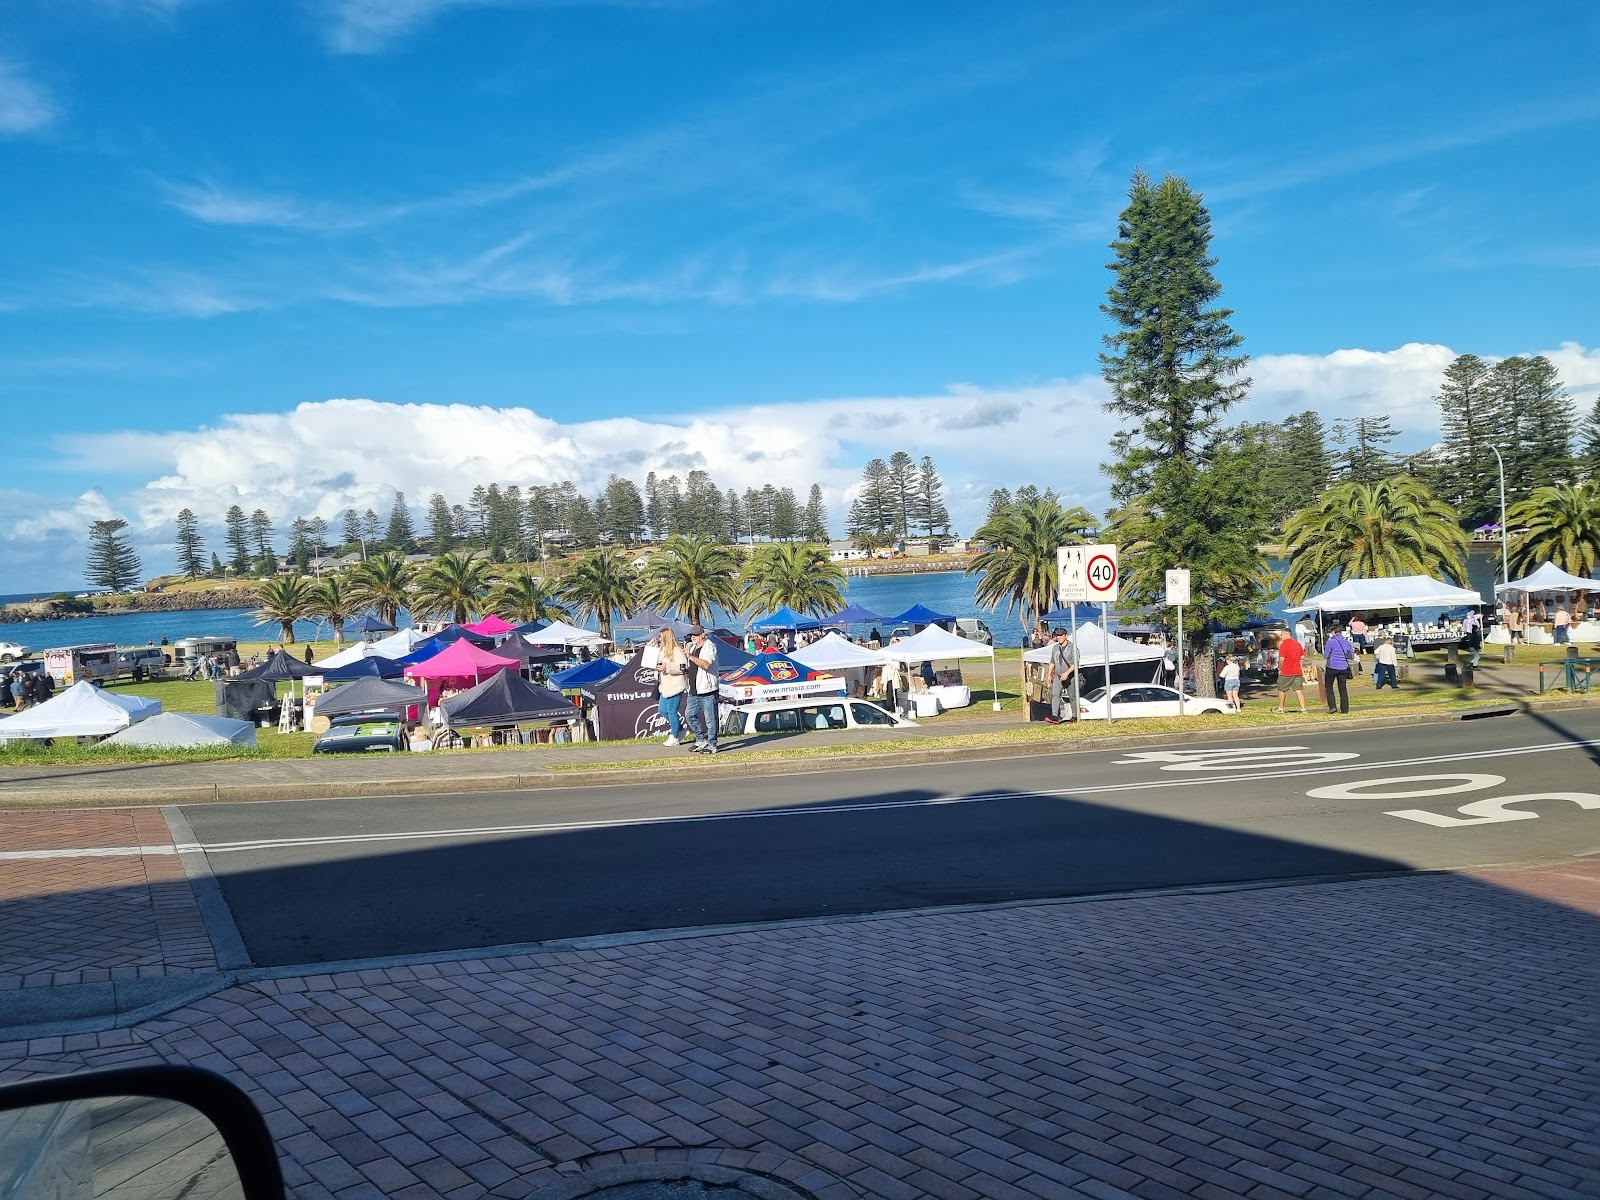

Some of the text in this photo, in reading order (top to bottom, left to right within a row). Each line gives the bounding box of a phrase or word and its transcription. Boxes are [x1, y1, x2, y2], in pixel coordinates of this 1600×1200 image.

[1092, 565, 1111, 581] 40
[1426, 631, 1467, 640] AUSTRALI
[763, 684, 821, 694] www.nrlasia.com
